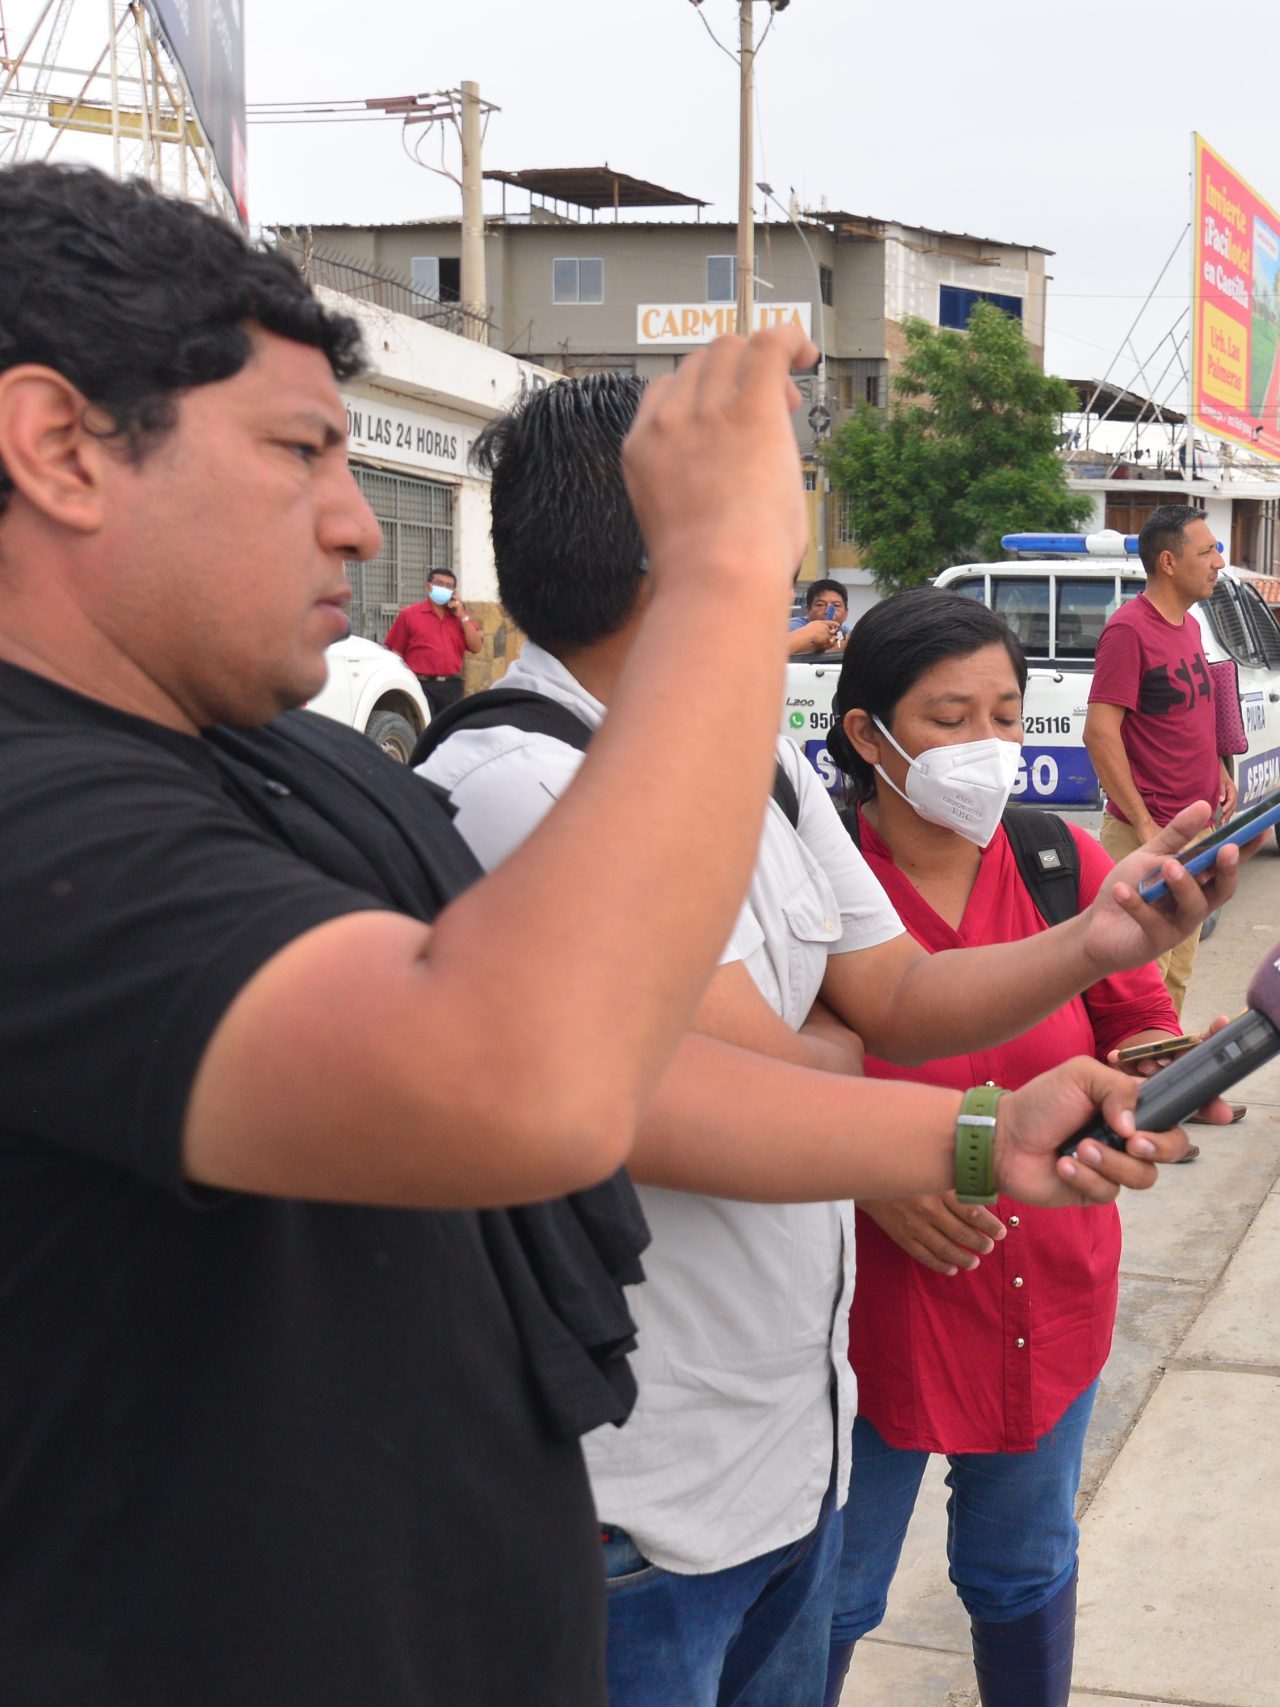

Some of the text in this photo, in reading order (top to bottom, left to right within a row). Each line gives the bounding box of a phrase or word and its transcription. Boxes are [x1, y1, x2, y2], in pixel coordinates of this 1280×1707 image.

[1205, 174, 1247, 234] Invierte
[1204, 261, 1216, 286] en
[1216, 265, 1249, 309] Castilla
[642, 307, 806, 339] CARMEITA
[1210, 326, 1241, 362] Urb. Las
[1207, 354, 1243, 392] Palmeras
[367, 414, 392, 445] LAS
[396, 422, 412, 450] 24
[416, 427, 457, 460] HORAS
[785, 697, 815, 707] L200
[1246, 703, 1266, 733] PIURA
